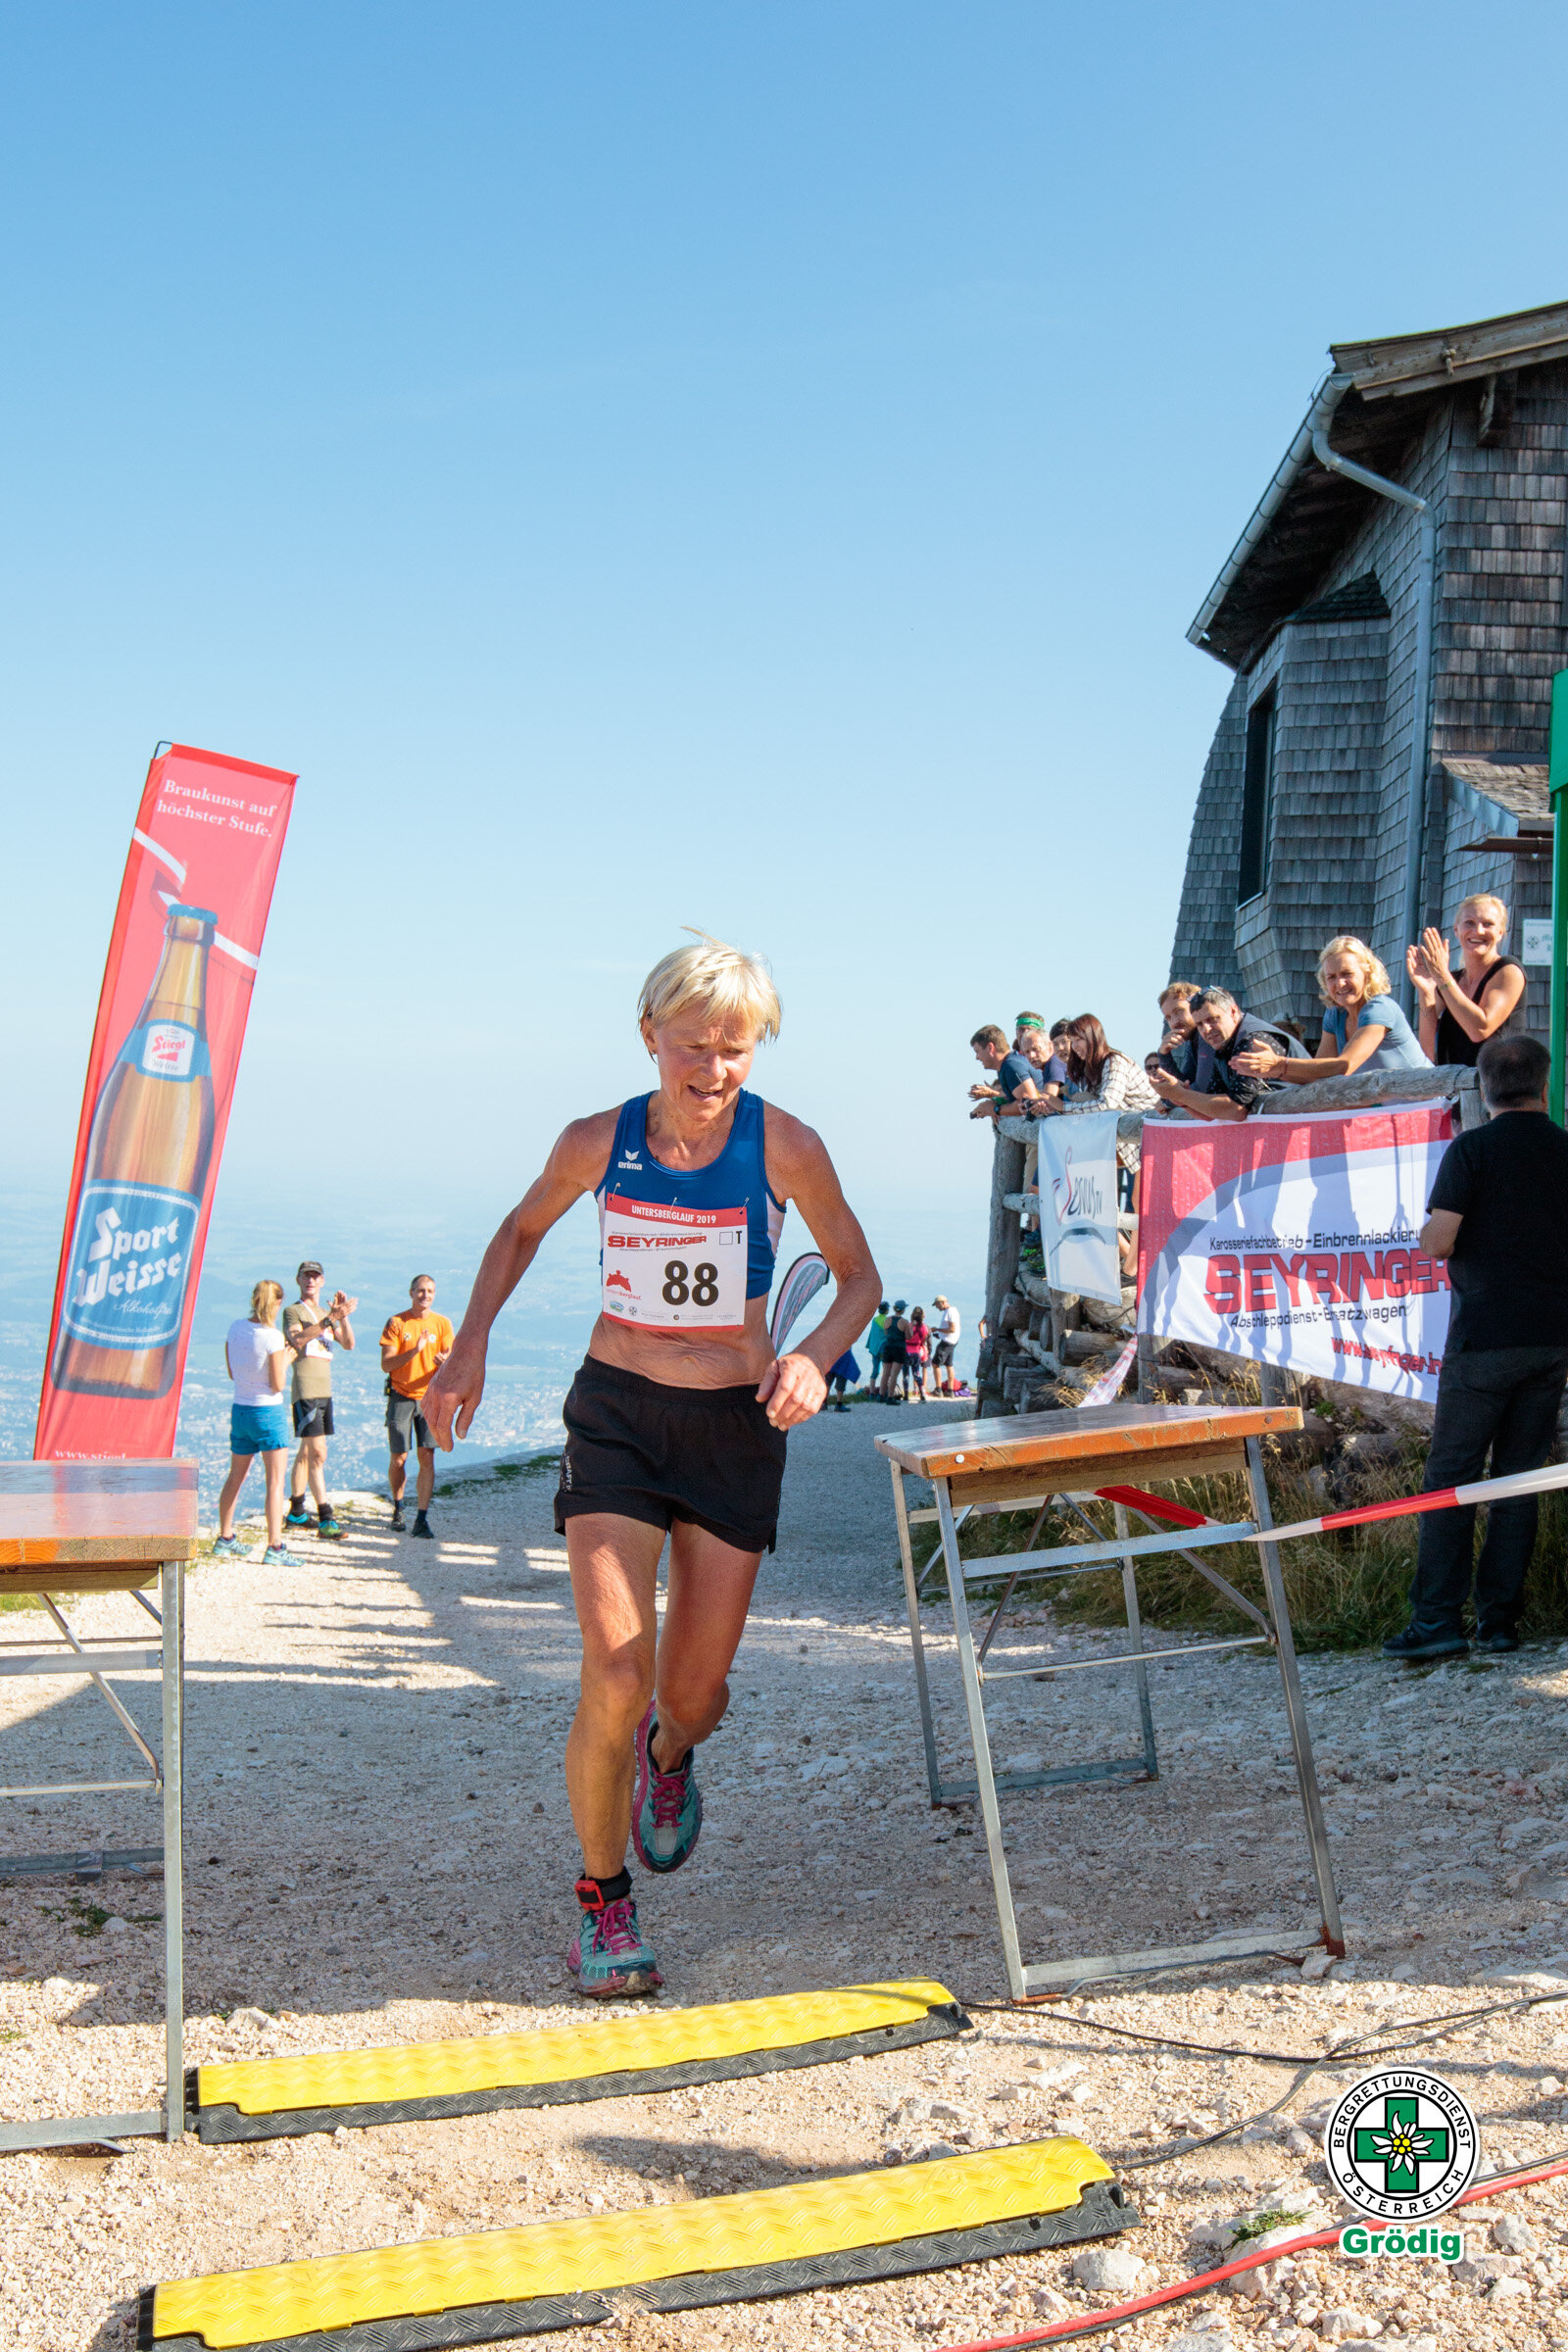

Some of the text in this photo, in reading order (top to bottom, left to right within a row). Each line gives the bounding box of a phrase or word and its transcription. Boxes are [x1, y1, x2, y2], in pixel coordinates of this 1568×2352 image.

[164, 779, 277, 817] Braukunst auf
[157, 800, 272, 838] höchster Stufe.
[152, 1035, 186, 1053] Stiegl
[618, 1160, 643, 1171] erima
[631, 1204, 716, 1224] UNTERSBERGLAUF 2019
[88, 1206, 179, 1263] Sport
[607, 1235, 708, 1249] SEYRINGER
[735, 1230, 743, 1245] T
[72, 1251, 181, 1307] Weisse
[662, 1259, 719, 1307] 88
[1202, 1248, 1451, 1315] SEYRINGER
